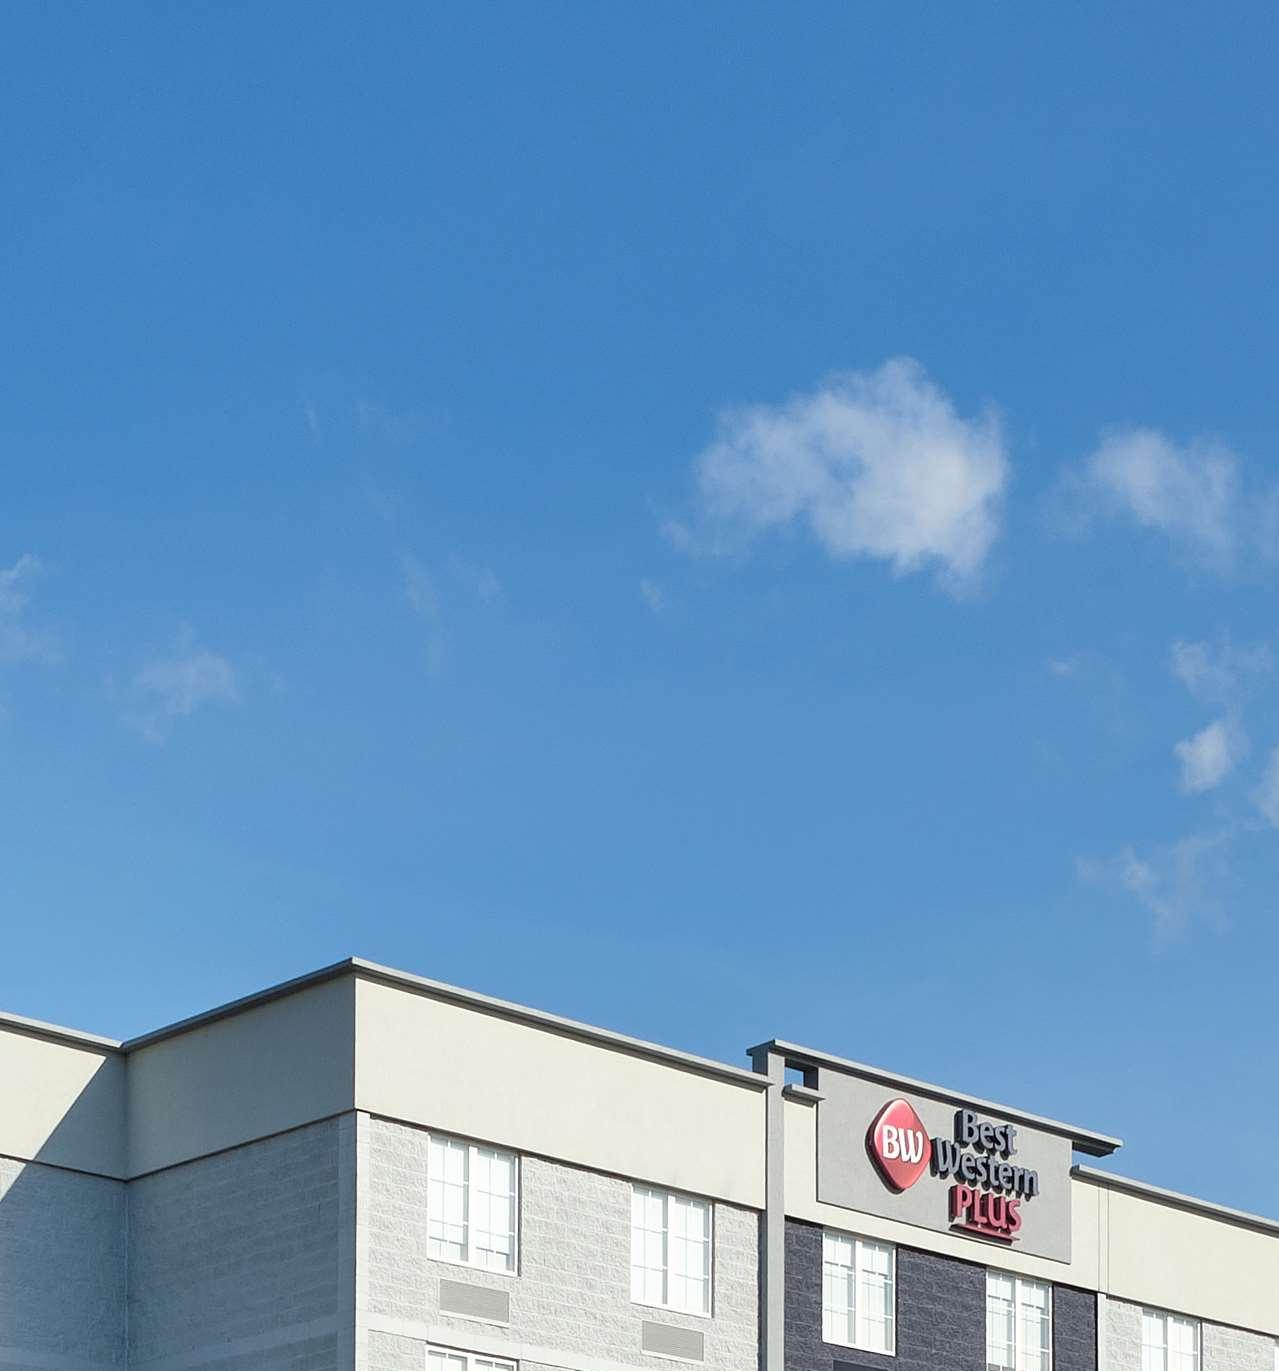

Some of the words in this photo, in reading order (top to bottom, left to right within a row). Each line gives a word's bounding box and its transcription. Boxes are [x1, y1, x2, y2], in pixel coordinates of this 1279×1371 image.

[882, 1124, 924, 1164] BW
[955, 1108, 1018, 1158] Best
[931, 1137, 1040, 1199] Western
[948, 1184, 1023, 1233] PLUS
